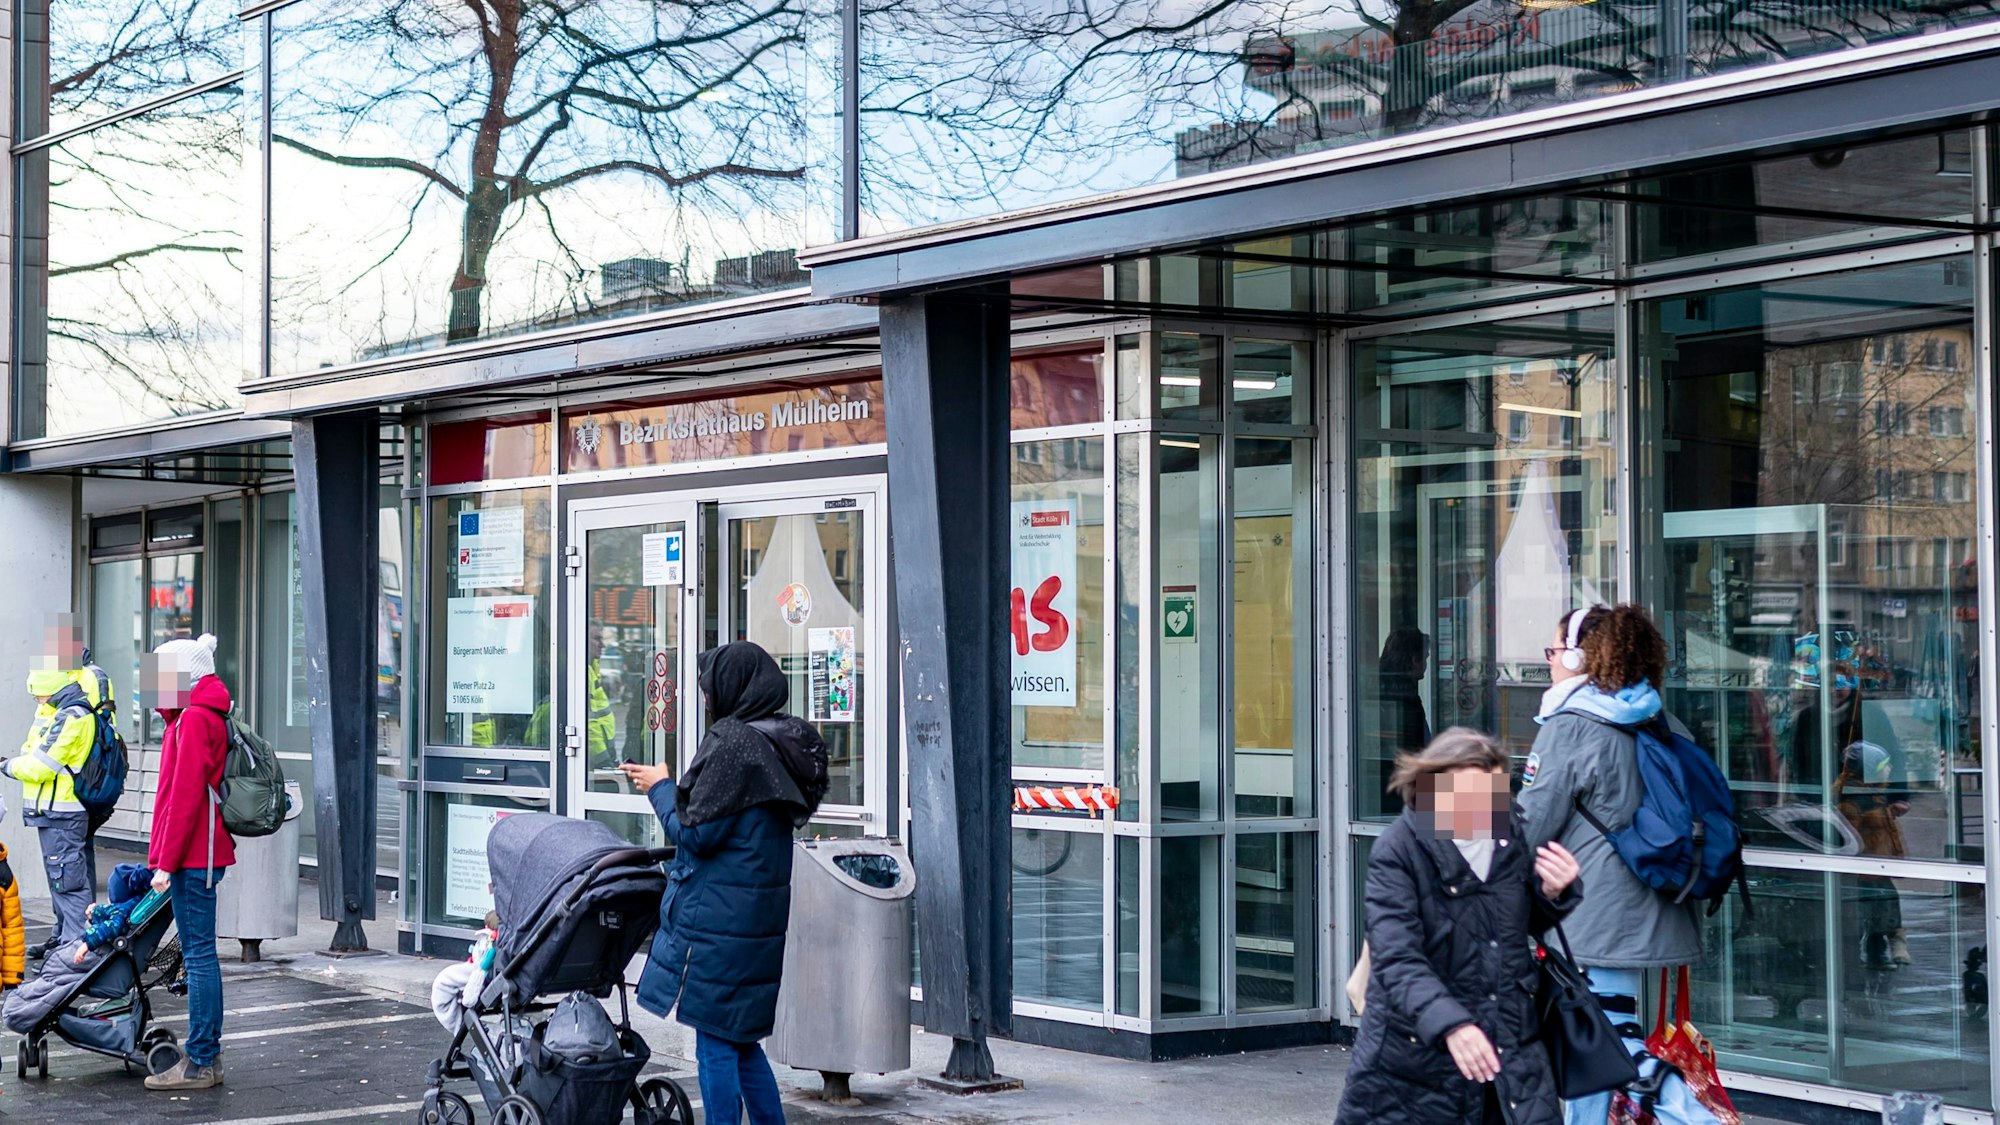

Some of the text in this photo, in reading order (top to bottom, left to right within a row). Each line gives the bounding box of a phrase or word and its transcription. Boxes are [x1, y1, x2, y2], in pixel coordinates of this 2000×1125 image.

[620, 395, 869, 446] Bezirksrathaus Mülheim
[1032, 515, 1058, 524] Stadt Köln
[453, 646, 509, 657] Bürgeramt Mülheim
[453, 681, 495, 690] Wiener Platz 2a
[1011, 671, 1069, 692] wissen.
[453, 695, 484, 704] 51065 Köln
[451, 903, 468, 912] Telefon
